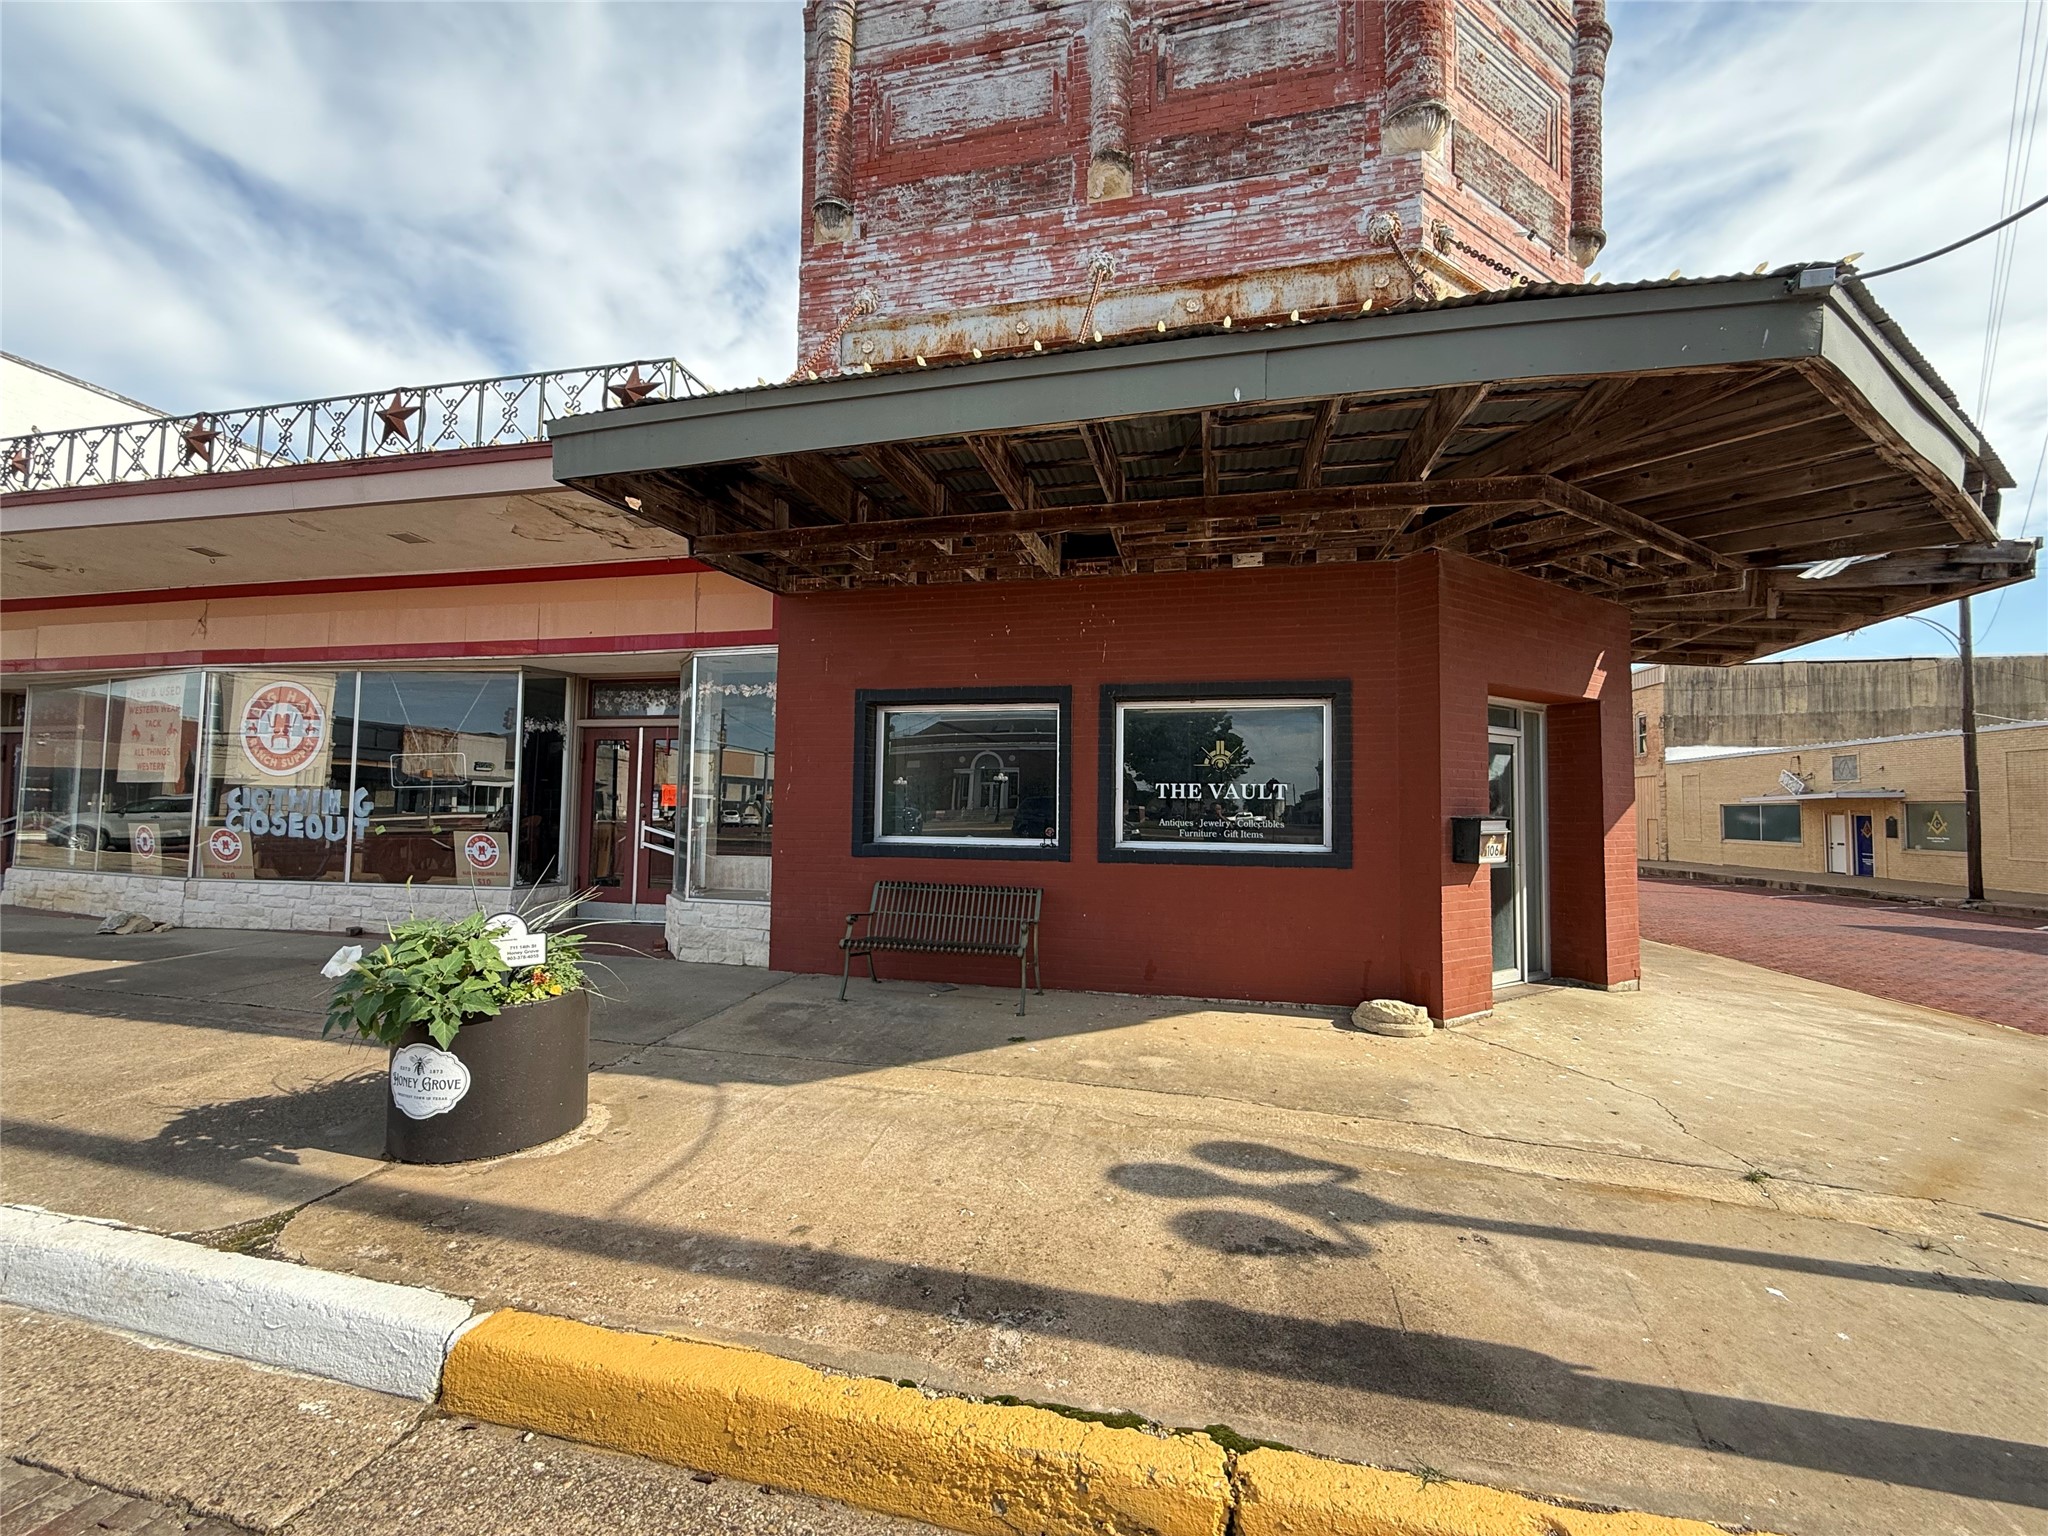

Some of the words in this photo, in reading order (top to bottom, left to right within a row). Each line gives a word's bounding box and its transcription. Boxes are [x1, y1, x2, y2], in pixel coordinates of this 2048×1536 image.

[130, 687, 148, 698] NEW
[160, 686, 181, 697] USED
[128, 705, 159, 715] WESTERN
[161, 704, 182, 713] WEAR
[249, 691, 277, 717] BIG
[287, 690, 315, 718] HAT
[145, 719, 162, 728] TACK
[134, 748, 145, 757] ALL
[146, 747, 171, 756] THINGS
[249, 737, 278, 768] RANCH
[281, 737, 315, 768] SUPPLY
[136, 762, 166, 771] WESTERN
[1155, 782, 1203, 799] THE
[1208, 782, 1288, 800] VAULT
[1158, 818, 1194, 829] Antiques
[1199, 818, 1231, 829] Jewelry
[1237, 819, 1285, 829] Collectibles
[1179, 829, 1218, 838] Furniture
[1223, 829, 1239, 839] Gift
[1240, 830, 1264, 839] Items
[1487, 844, 1500, 857] 106
[392, 1071, 419, 1089] HONEY
[418, 1076, 462, 1093] GROVE
